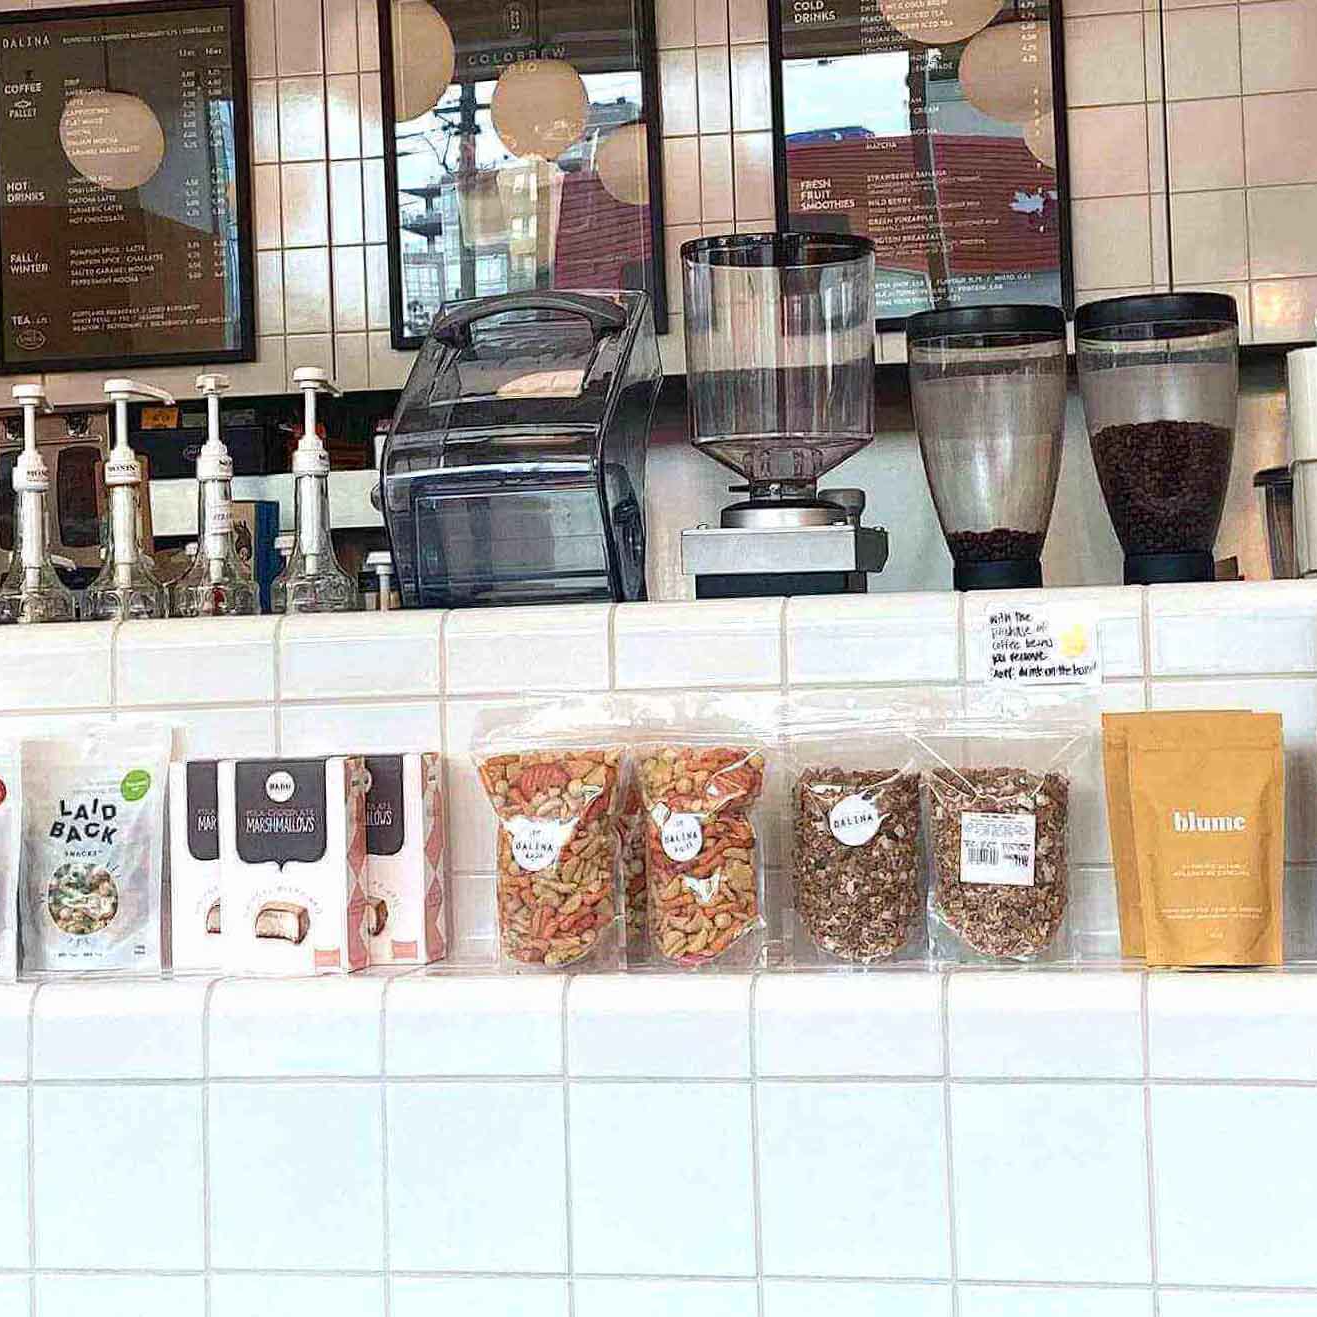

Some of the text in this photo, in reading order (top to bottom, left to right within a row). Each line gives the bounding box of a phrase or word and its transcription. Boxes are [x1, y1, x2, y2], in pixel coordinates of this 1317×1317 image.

[794, 1, 824, 11] COLD
[794, 11, 836, 23] DRINKS
[2, 34, 51, 49] DALINA
[4, 82, 43, 95] COFFEE
[6, 181, 27, 192] HOT
[800, 179, 832, 190] FRESH
[6, 191, 45, 203] DRINKS
[800, 189, 832, 200] FRUIT
[800, 199, 856, 211] SMOOTHIES
[10, 253, 32, 264] FALL
[10, 263, 49, 274] WINTER
[11, 315, 30, 326] TEA
[990, 612, 1011, 624] with
[60, 798, 117, 820] LAID
[246, 816, 315, 832] MARSHMALLOWS
[834, 814, 874, 829] DALINA
[1173, 810, 1246, 833] blume
[49, 822, 117, 845] BACK
[664, 832, 698, 843] DALINA
[516, 842, 553, 851] DALINA
